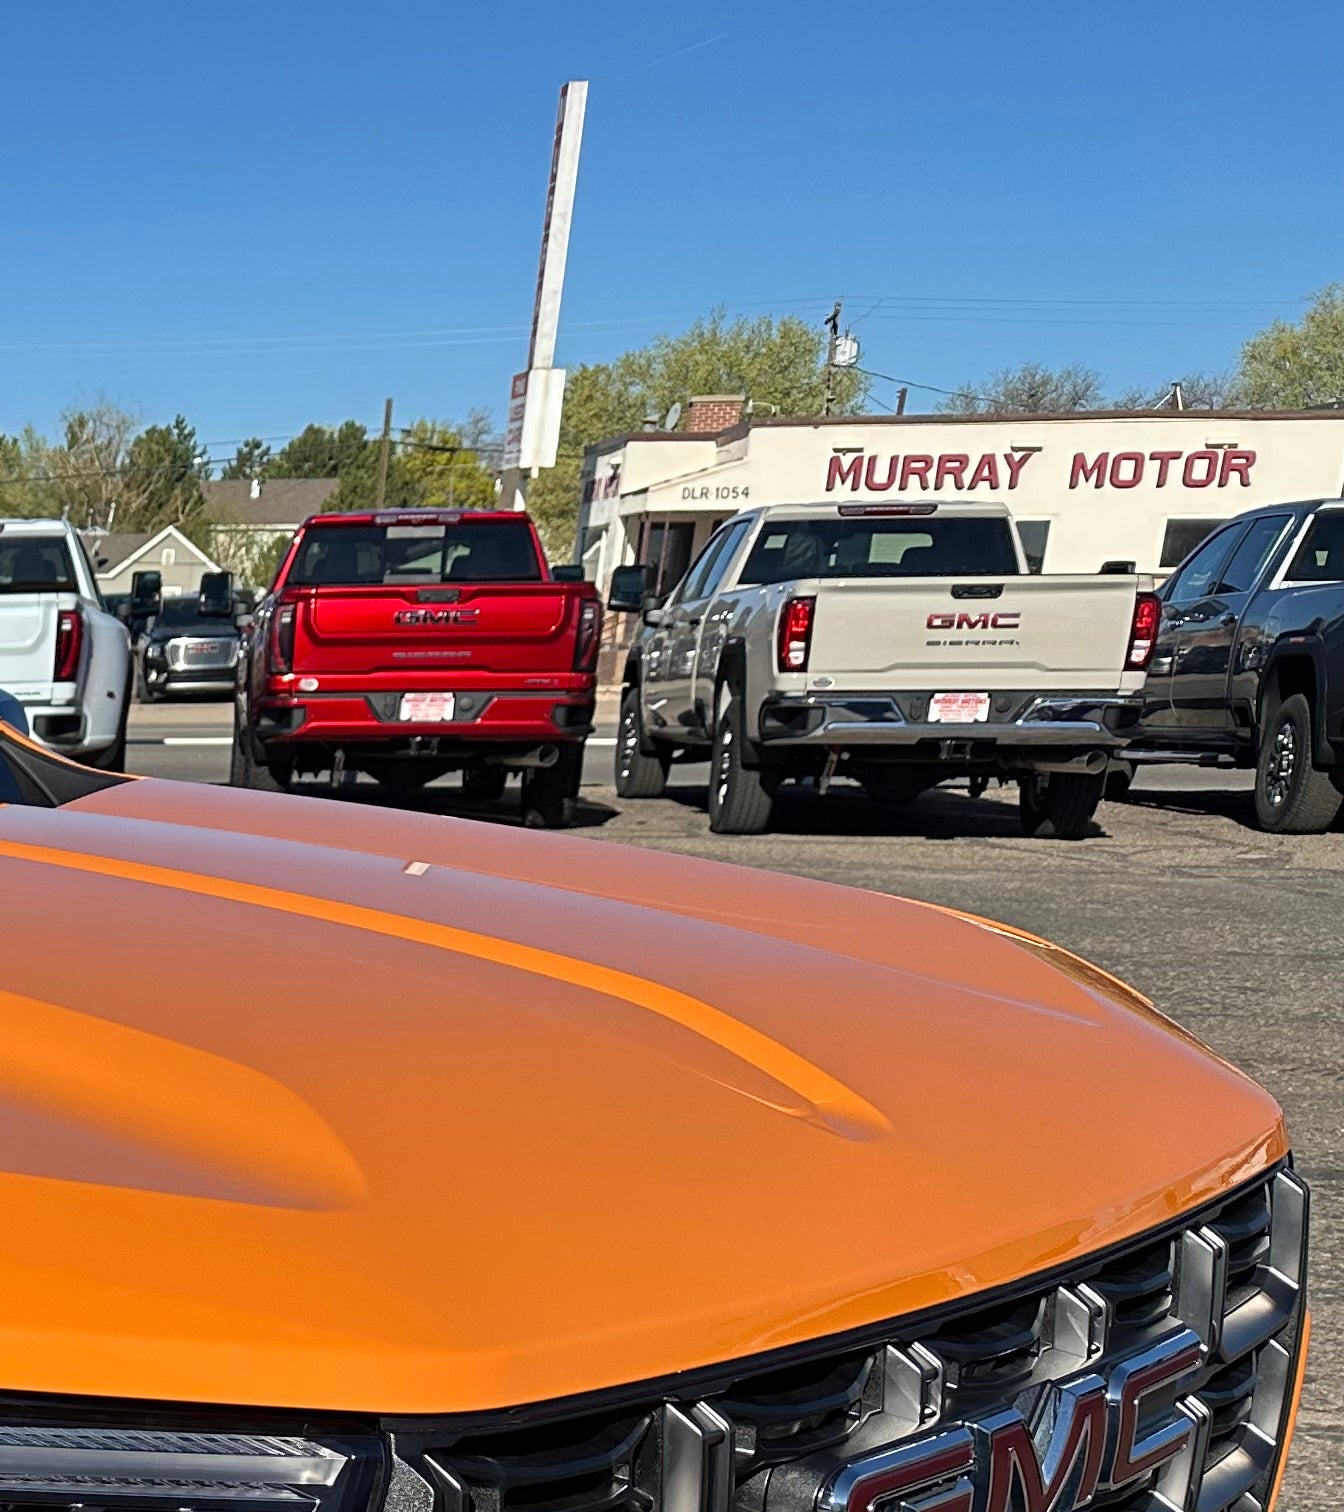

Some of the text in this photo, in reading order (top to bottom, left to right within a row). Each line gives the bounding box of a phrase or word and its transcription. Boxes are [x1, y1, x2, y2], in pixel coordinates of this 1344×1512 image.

[826, 449, 1257, 492] MURRAY MOTOR
[394, 609, 481, 626] GMC
[925, 612, 1022, 630] GMC
